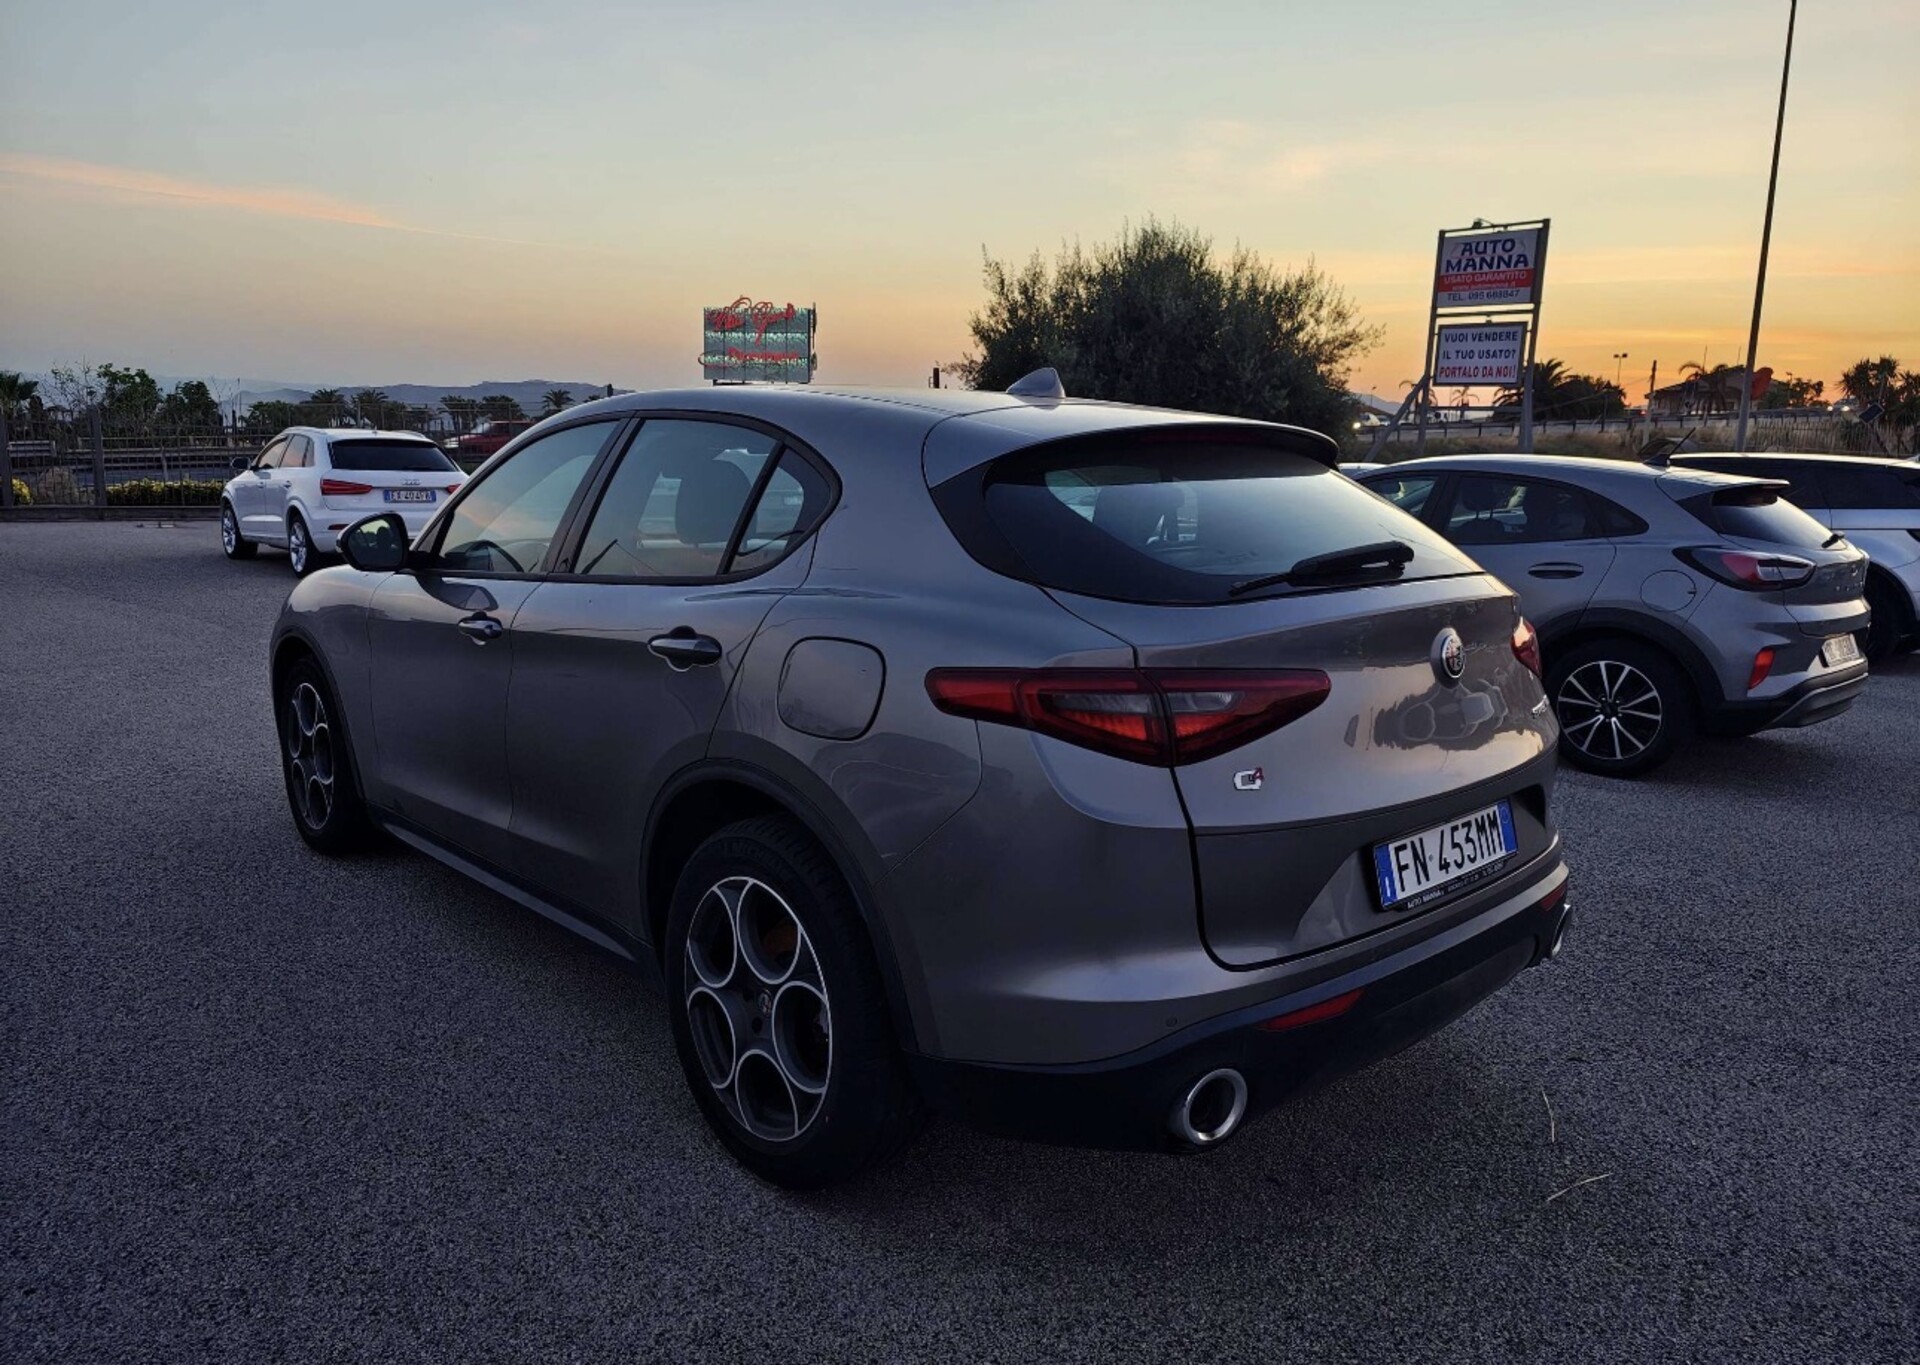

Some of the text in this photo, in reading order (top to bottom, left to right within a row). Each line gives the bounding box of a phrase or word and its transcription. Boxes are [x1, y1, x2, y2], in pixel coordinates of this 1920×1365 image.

[1461, 239, 1515, 256] AUTO
[1446, 254, 1528, 272] MANNA
[1444, 270, 1527, 284] USATO GARANTITO
[1444, 330, 1518, 343] VUOI VENDERE
[1442, 349, 1516, 360] IL TUO USATO?
[1439, 366, 1516, 379] PORTALO DA NOI!
